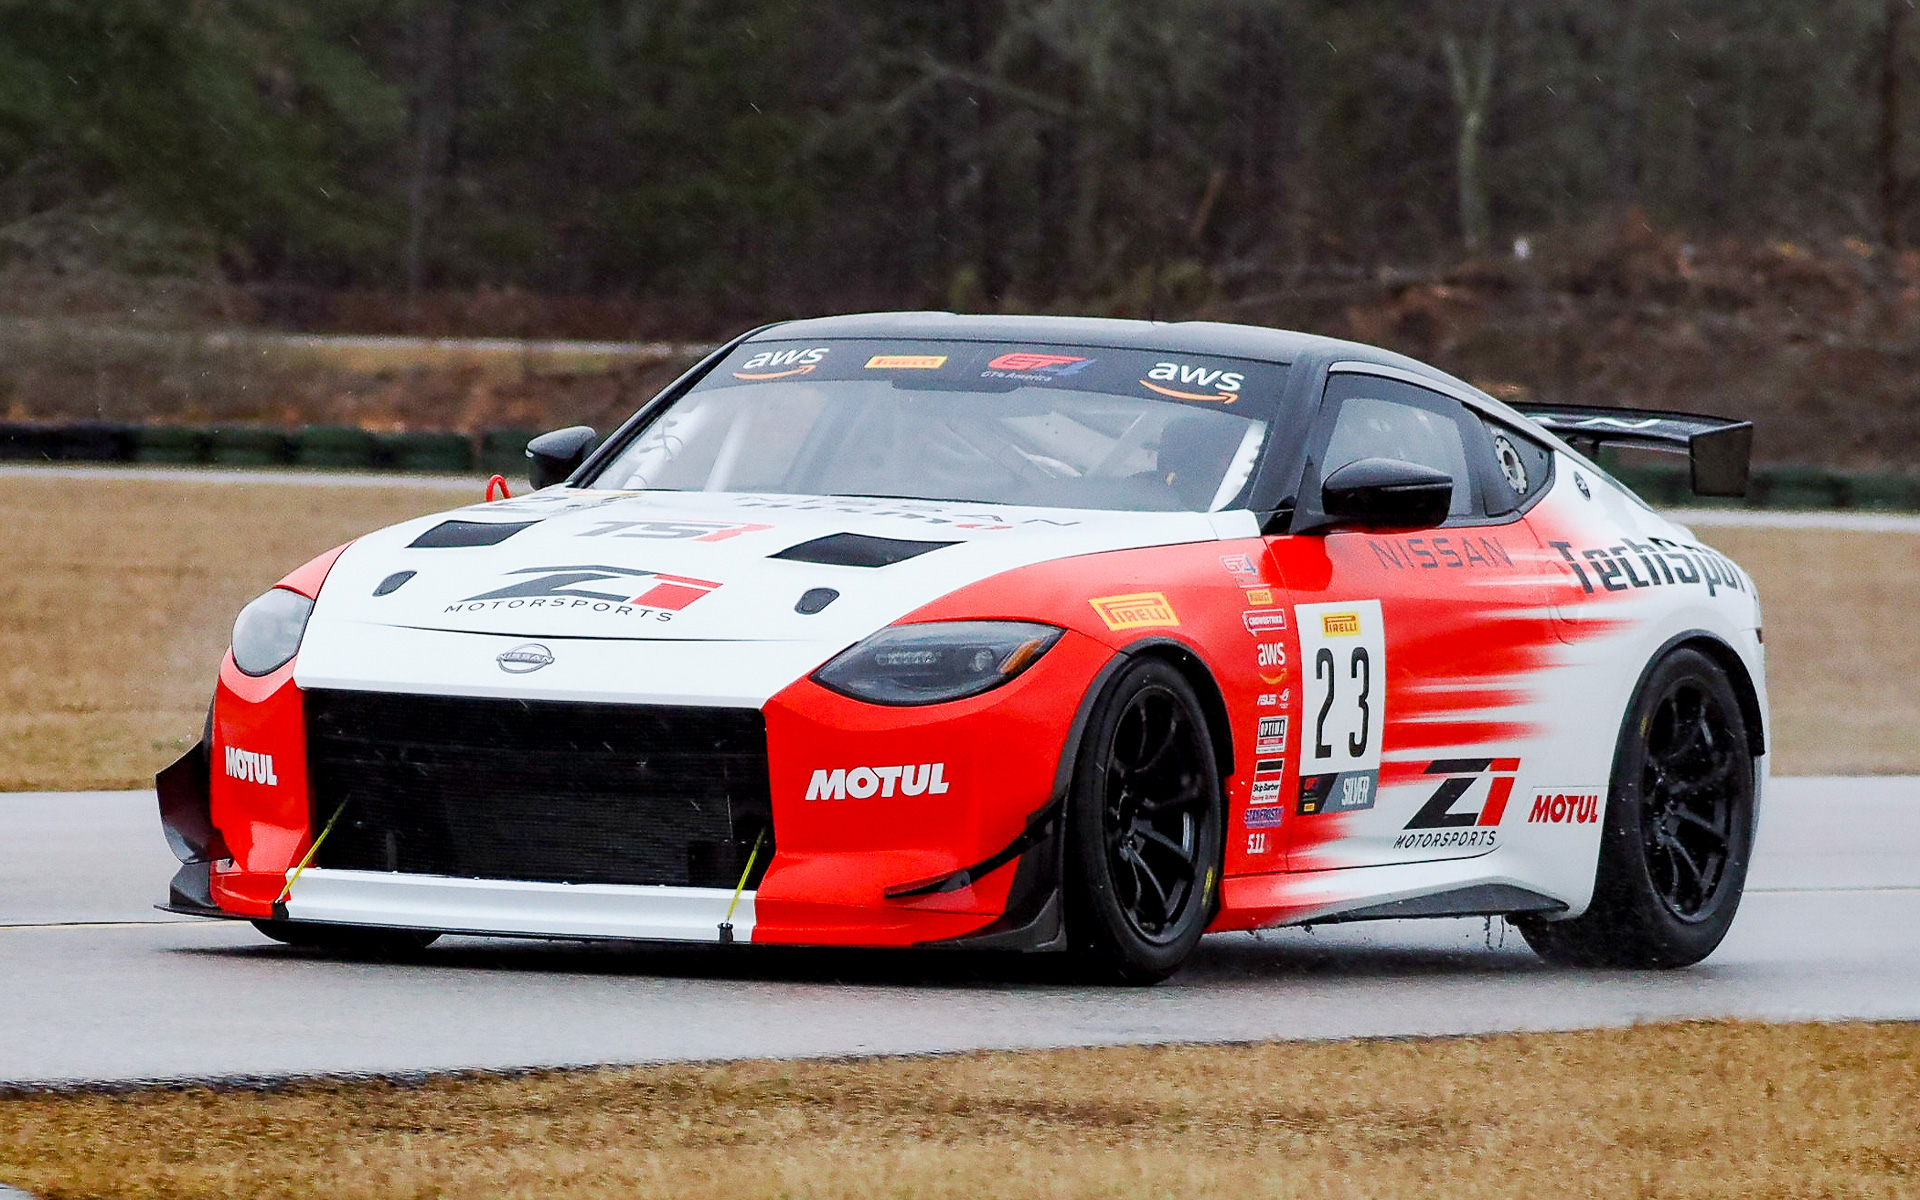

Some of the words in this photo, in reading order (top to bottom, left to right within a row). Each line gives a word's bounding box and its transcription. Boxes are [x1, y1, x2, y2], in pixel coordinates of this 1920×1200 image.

[743, 348, 830, 369] aws
[1147, 362, 1246, 391] aws
[1368, 536, 1516, 570] NISSAN
[444, 598, 673, 622] MOTORSPORTS
[1097, 597, 1172, 624] PIRELLI
[1324, 614, 1358, 633] PIRELLI
[1256, 642, 1286, 667] aws
[1315, 646, 1370, 759] 23
[1260, 720, 1284, 738] OPTIMA
[225, 745, 278, 787] MOTUL
[804, 762, 950, 801] MOTUL
[1341, 775, 1370, 806] SILVER
[1527, 794, 1599, 824] MOTUL
[1393, 830, 1498, 850] MOTORSPORTS
